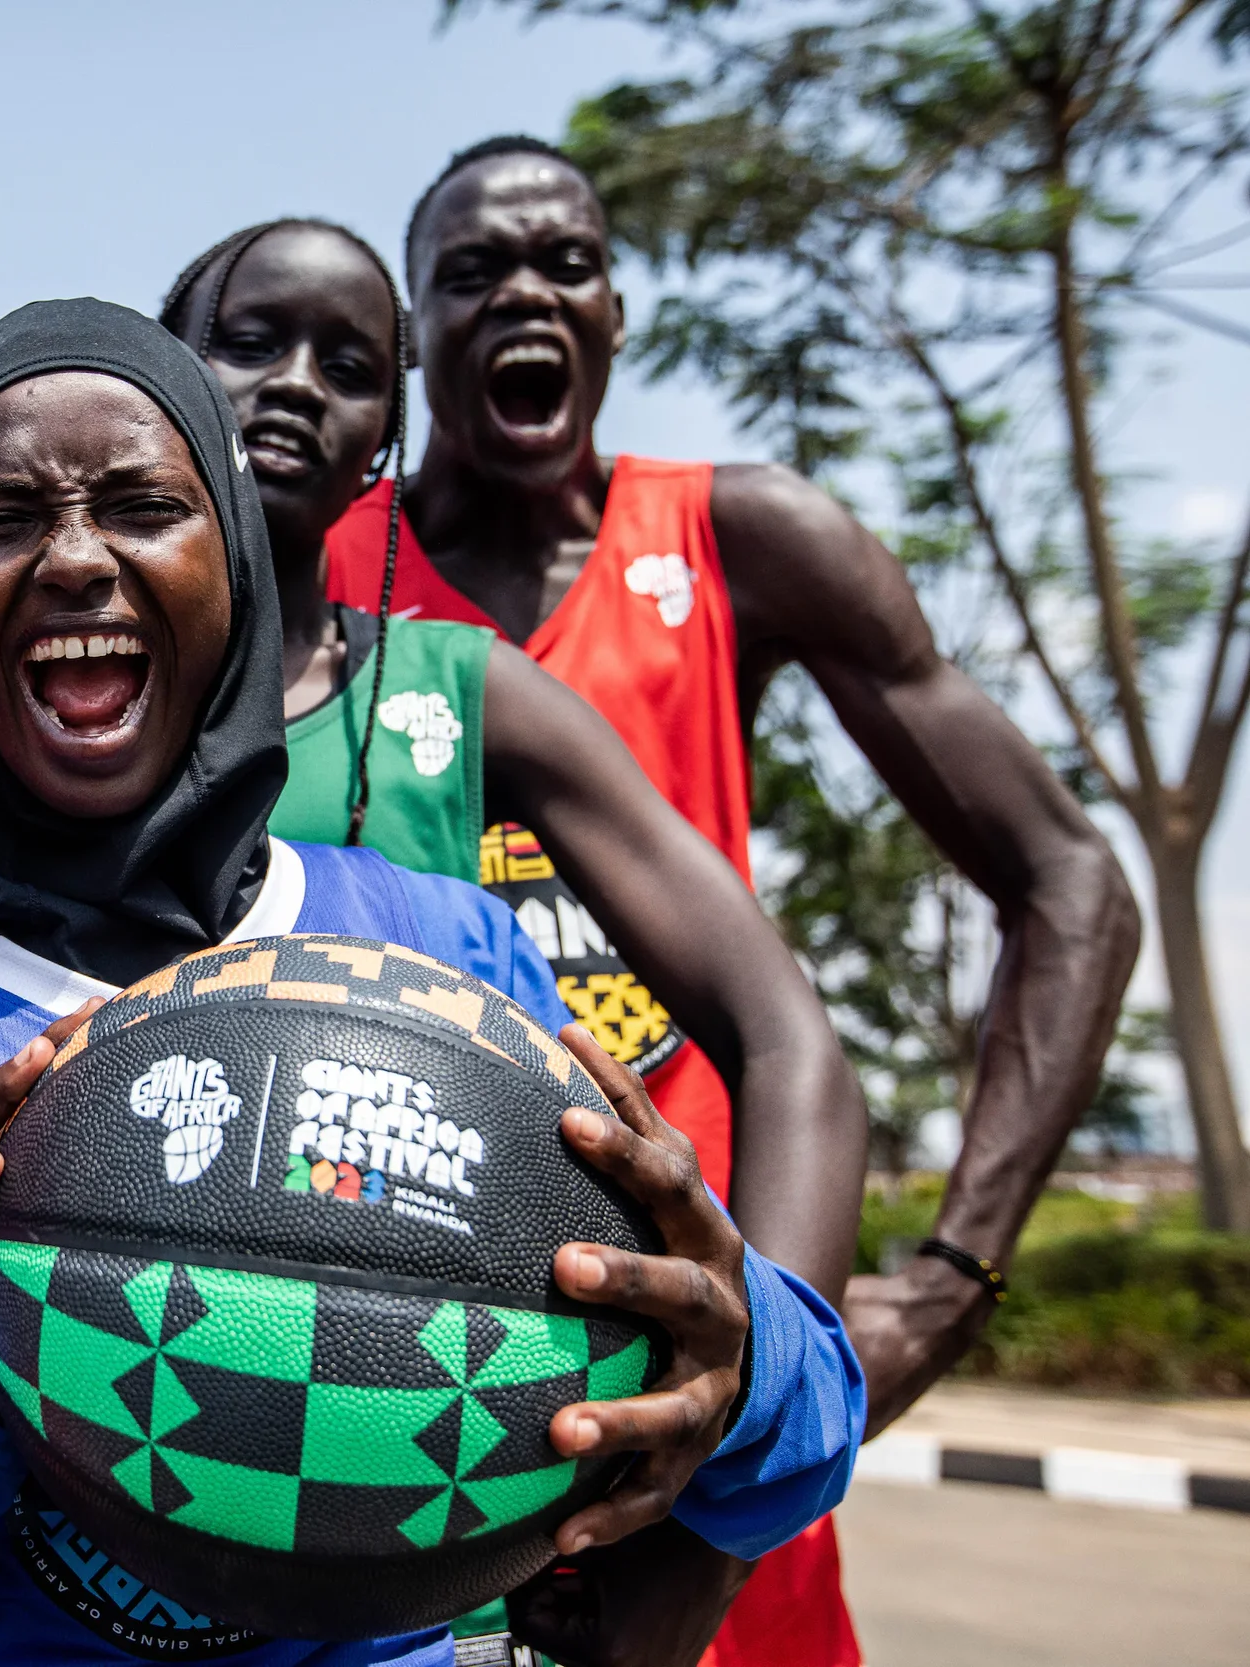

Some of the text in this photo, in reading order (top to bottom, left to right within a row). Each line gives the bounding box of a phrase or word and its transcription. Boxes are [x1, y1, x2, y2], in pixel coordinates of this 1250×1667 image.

[130, 1054, 230, 1105] GIANTS
[301, 1058, 436, 1112] GIANTS
[131, 1093, 244, 1132] OF AFRICA
[296, 1089, 485, 1165] OF AFRICA
[284, 1153, 387, 1205] 2023
[288, 1120, 475, 1198] FESTIVAL
[392, 1199, 474, 1236] RWANDA
[394, 1185, 456, 1215] KIGALI
[20, 1525, 69, 1592] AFRICA
[76, 1601, 101, 1619] OF
[112, 1622, 189, 1650] GIANTS
